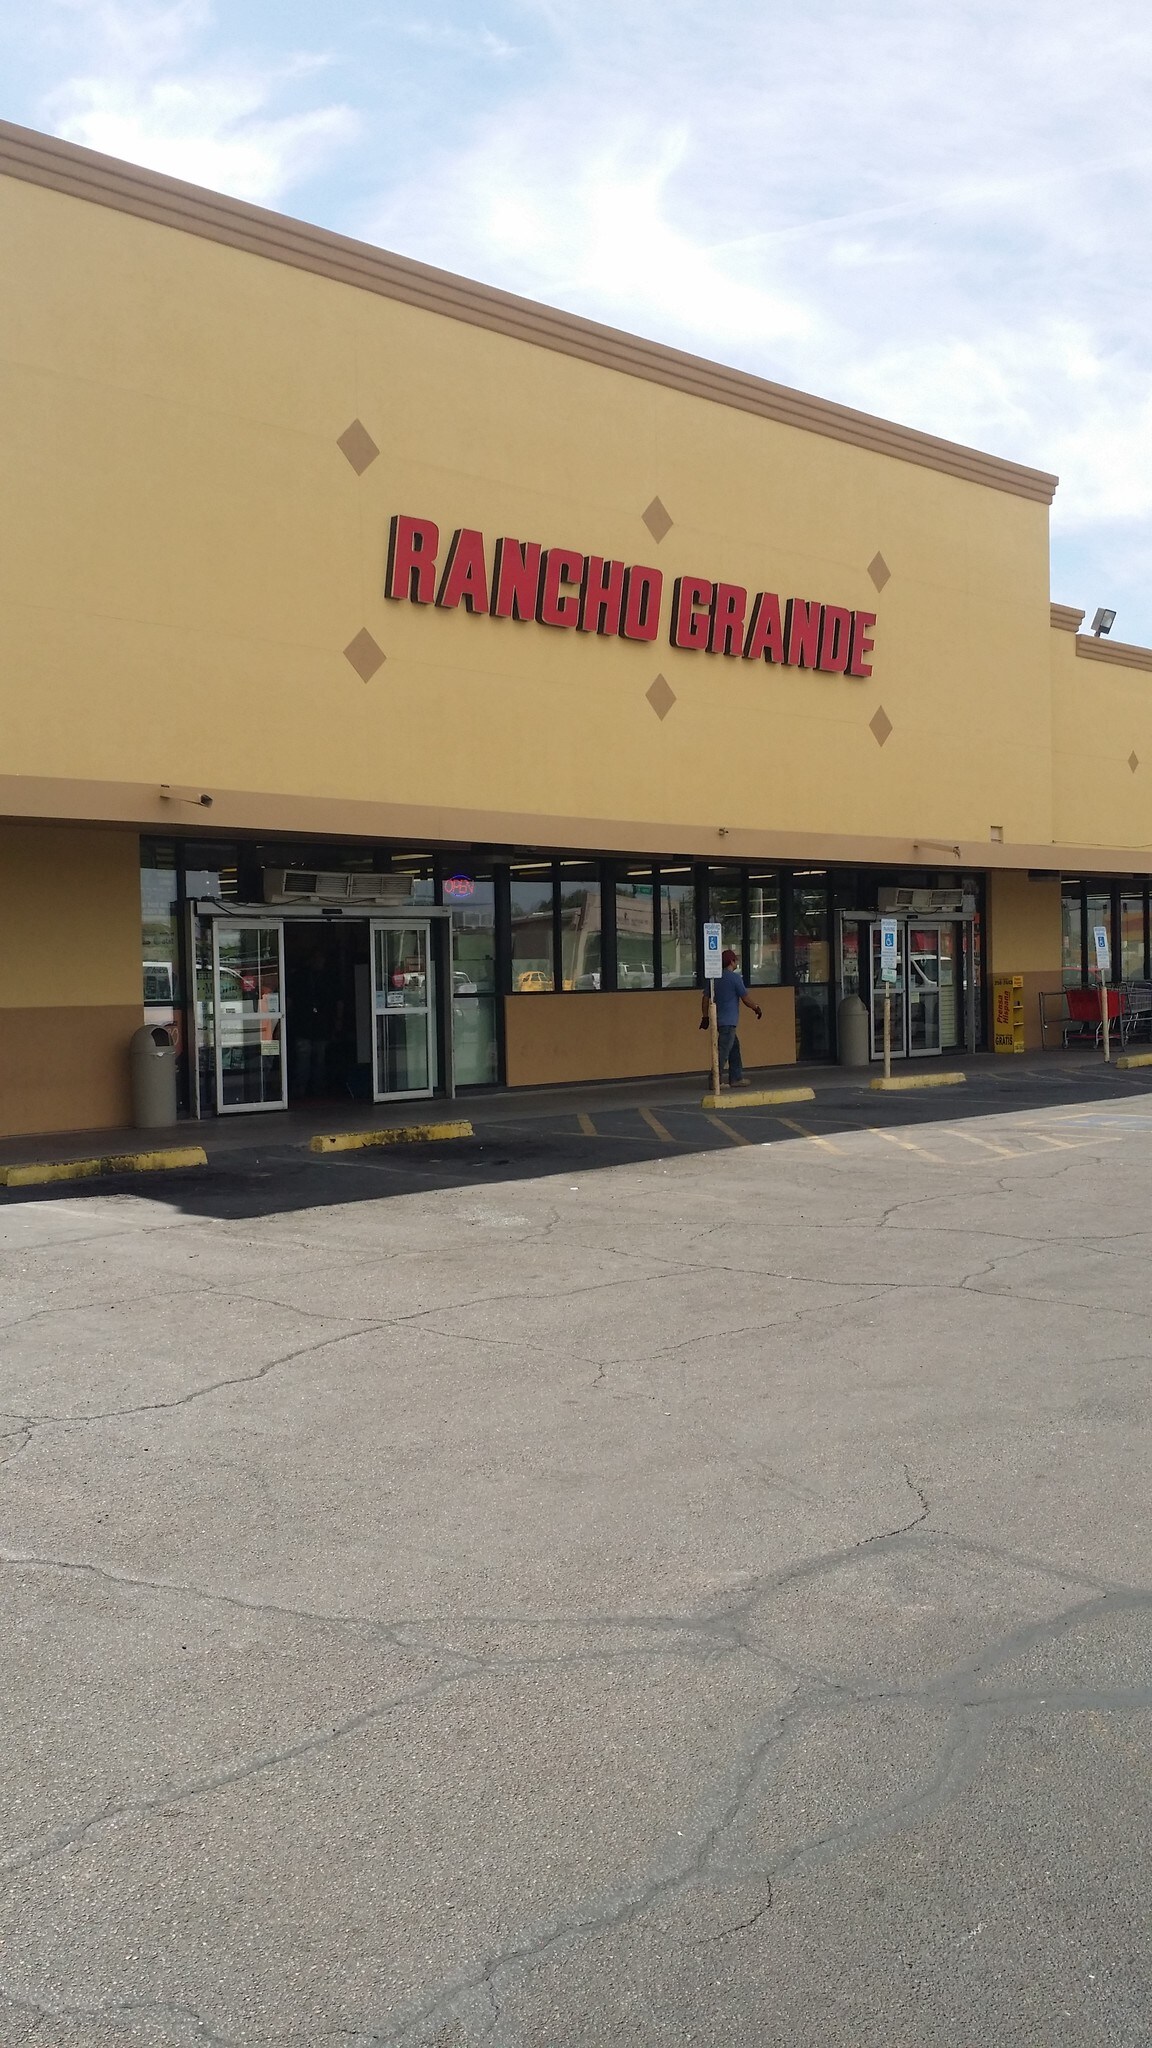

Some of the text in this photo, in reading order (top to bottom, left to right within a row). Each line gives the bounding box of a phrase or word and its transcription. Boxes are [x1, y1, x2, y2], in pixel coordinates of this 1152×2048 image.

[384, 514, 877, 678] RANCHO GRANDE
[444, 878, 475, 895] OPEN
[996, 1037, 1013, 1046] GRATIS
